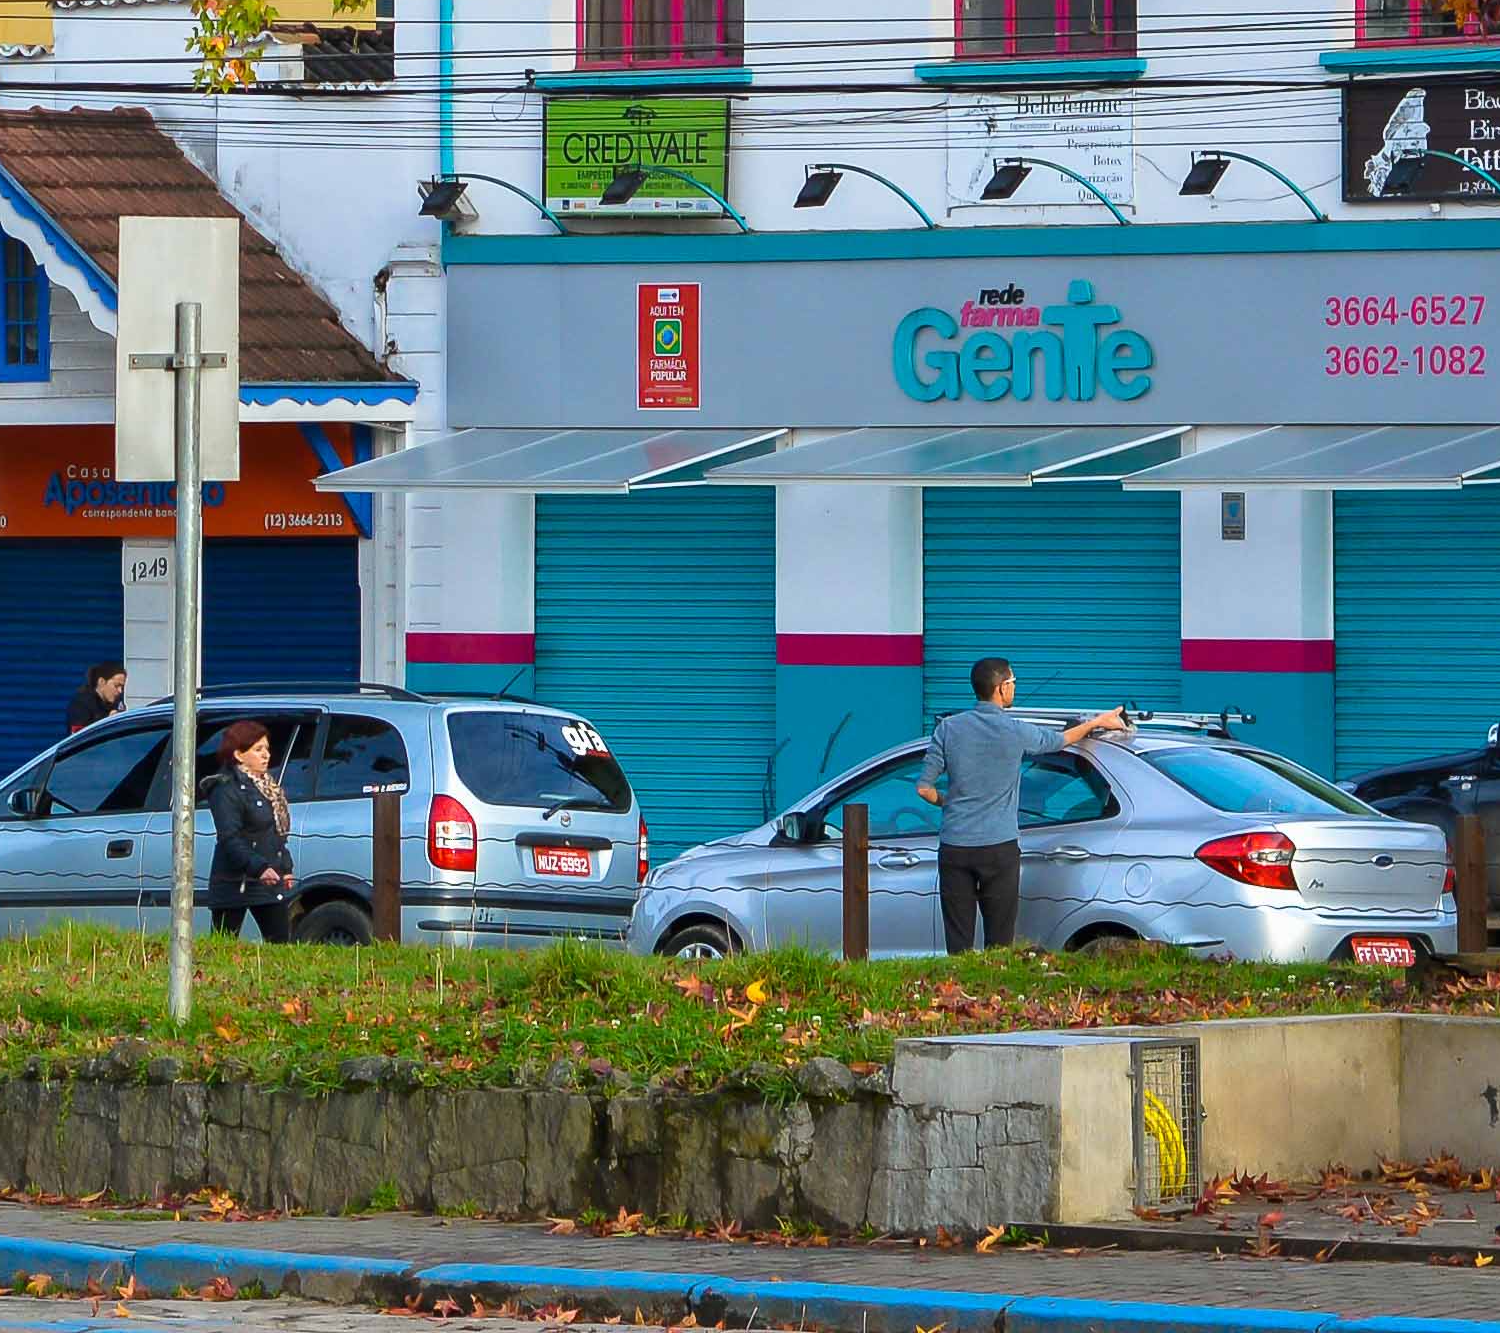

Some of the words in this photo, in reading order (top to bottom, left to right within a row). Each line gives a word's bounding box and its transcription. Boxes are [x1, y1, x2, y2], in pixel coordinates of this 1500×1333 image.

[978, 282, 1026, 306] rede
[649, 305, 668, 317] AQUI
[668, 305, 684, 316] TEM
[959, 300, 1041, 328] farma
[1325, 294, 1486, 327] 3664-6527
[1325, 344, 1486, 376] 3662-1082
[650, 370, 688, 382] POPULAR
[66, 464, 112, 479] Casa
[263, 513, 287, 530] (12)
[287, 513, 344, 529] 3664-2113
